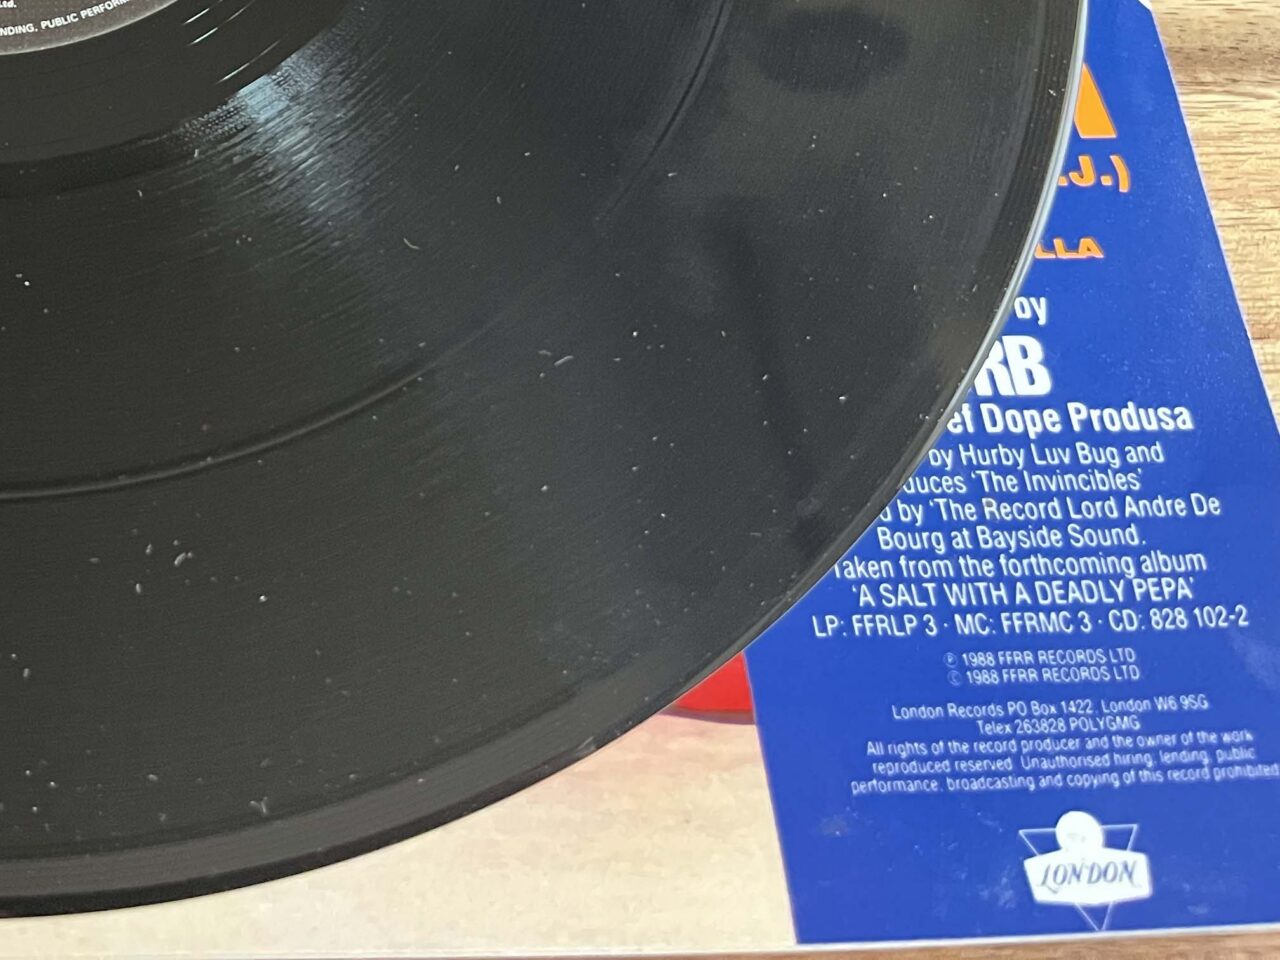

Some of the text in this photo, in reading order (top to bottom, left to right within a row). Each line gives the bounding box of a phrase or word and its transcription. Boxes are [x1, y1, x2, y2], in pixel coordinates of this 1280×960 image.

[41, 13, 79, 29] PUBLIC
[980, 403, 1061, 440] Dope
[1067, 401, 1194, 431] Produsa
[958, 441, 1165, 470] Hurby Luv Bug and
[896, 498, 923, 526] by
[981, 497, 1062, 521] Record
[1066, 496, 1118, 519] Lord
[1124, 494, 1187, 518] Andre
[1190, 492, 1221, 516] De
[876, 523, 1147, 554] Bourg at Bayside Sound.
[899, 549, 1208, 579] from the forthcoming album
[879, 582, 937, 608] SALT
[943, 581, 1009, 607] WITH
[1015, 581, 1032, 605] A
[1034, 579, 1125, 605] DEADLY
[812, 604, 1249, 637] LP: FFRLP 3 MC: FFRMC 3 CD: 828 102-2
[961, 647, 1136, 667] 1988 FFRR RECORDS LTD
[965, 664, 1140, 685] 1988 FFRR RECORDS LTD
[892, 694, 1209, 720] London Records PO Box London W6 9SG
[976, 714, 1140, 736] Telex 263828 POLYGMG
[1039, 860, 1141, 894] LONDON
